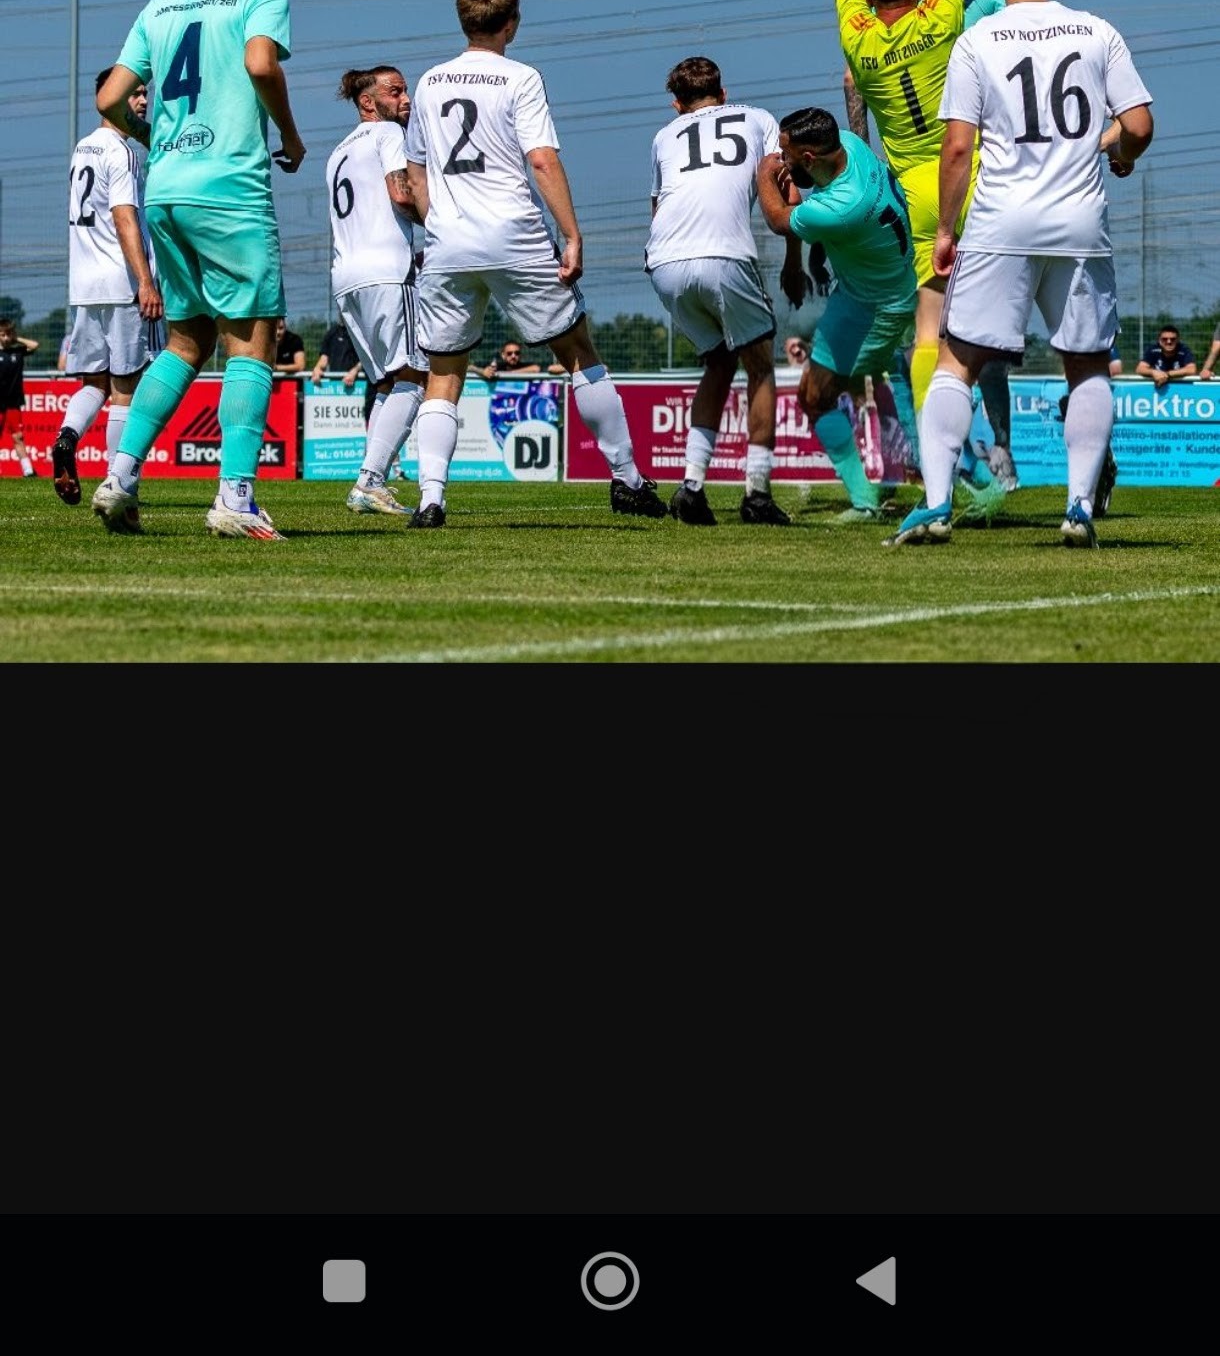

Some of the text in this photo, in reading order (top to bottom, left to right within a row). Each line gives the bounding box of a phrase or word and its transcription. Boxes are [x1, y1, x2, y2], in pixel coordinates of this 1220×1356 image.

[991, 24, 1093, 42] TSV NOTZINGEN
[161, 21, 203, 116] 4
[427, 73, 509, 86] TSV NOTZINGEN
[1005, 51, 1092, 144] 16
[900, 67, 929, 136] 1
[440, 98, 486, 176] 2
[676, 113, 748, 173] 15
[333, 155, 355, 220] 6
[314, 406, 331, 419] SIE
[514, 436, 551, 470] DJ
